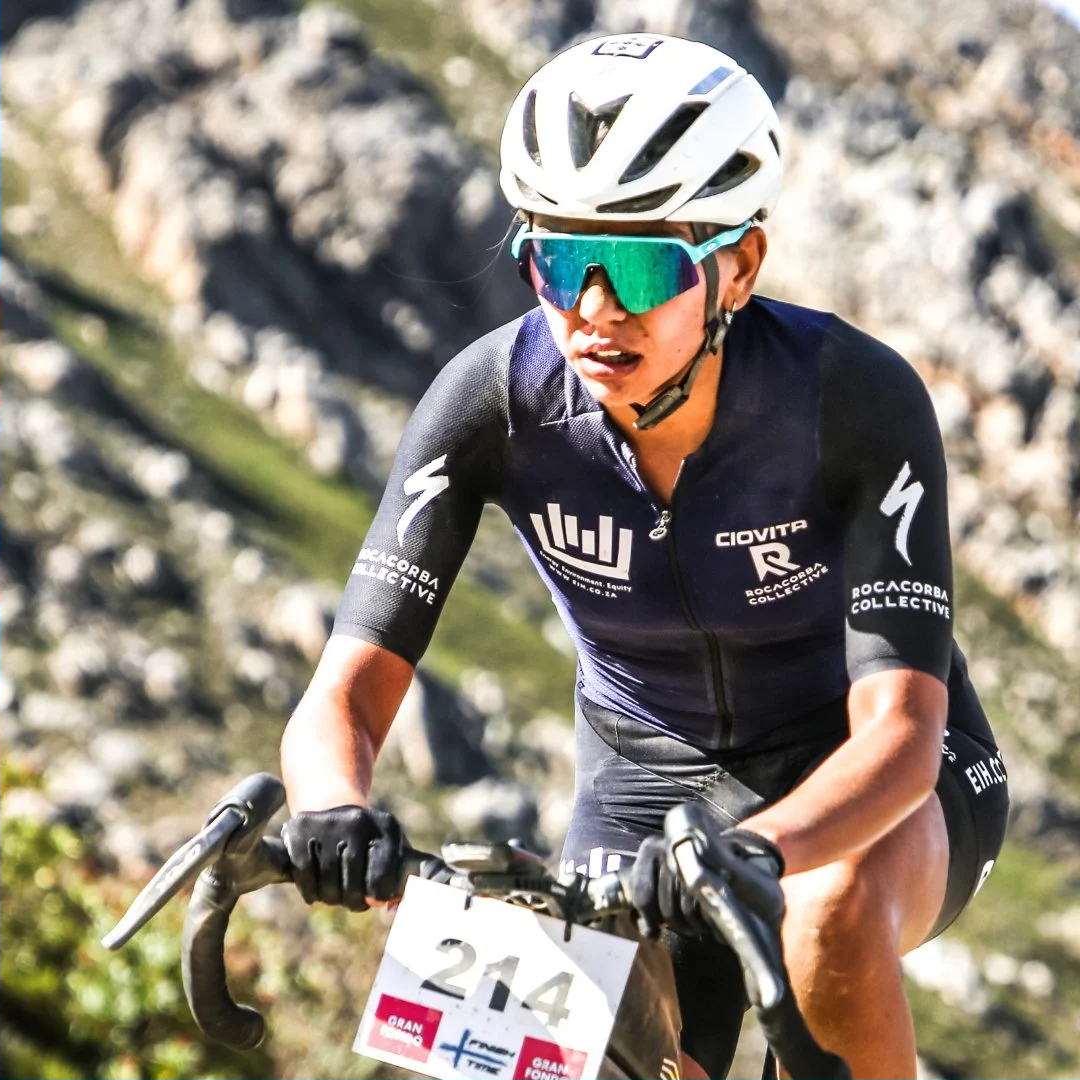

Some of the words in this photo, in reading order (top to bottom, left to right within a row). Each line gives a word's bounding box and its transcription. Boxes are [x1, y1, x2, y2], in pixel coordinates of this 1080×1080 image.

[715, 519, 808, 547] CIOVITA
[744, 562, 823, 597] ROCACORBA
[748, 565, 829, 605] COLLECTIVE
[851, 580, 949, 602] ROCACORBA
[851, 596, 950, 619] COLLECTIVE
[420, 938, 574, 1027] 214
[387, 1015, 423, 1035] GRAN
[532, 1057, 569, 1075] GRAN
